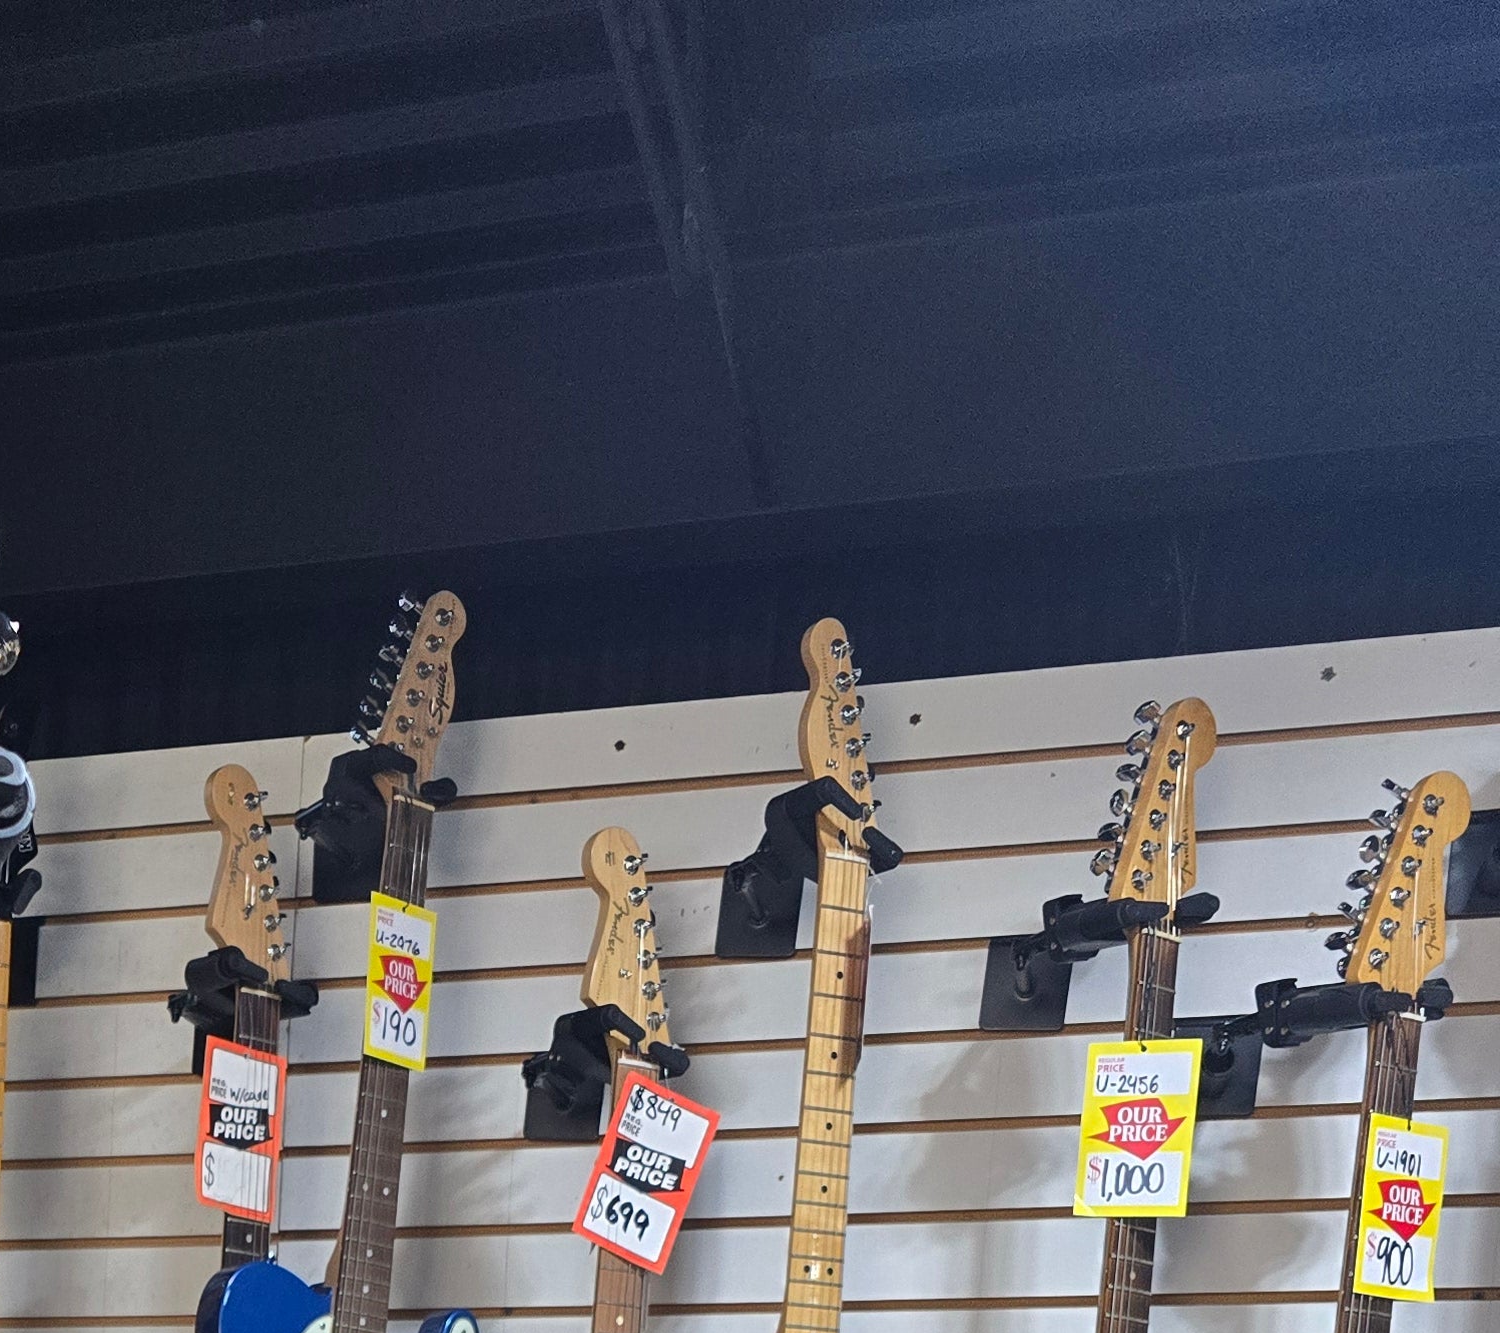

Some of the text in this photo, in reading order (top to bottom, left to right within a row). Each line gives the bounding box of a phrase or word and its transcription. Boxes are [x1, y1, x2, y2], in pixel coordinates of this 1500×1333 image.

[429, 661, 450, 725] Squier
[820, 684, 843, 749] Fender
[607, 898, 630, 955] Fender
[1423, 903, 1440, 960] Fender
[389, 959, 415, 982] OUR
[384, 975, 418, 1001] PRICE
[372, 1000, 417, 1047] $190
[1097, 1063, 1125, 1073] PRICE
[211, 1085, 227, 1099] PRICE
[1096, 1074, 1160, 1094] U-2456
[220, 1106, 258, 1125] OUR
[630, 1086, 682, 1132] $849
[1117, 1106, 1163, 1124] OUR
[213, 1120, 266, 1142] PRICE
[620, 1120, 642, 1138] PRICE
[1108, 1124, 1169, 1143] PRICE
[1376, 1137, 1397, 1149] PRICE
[203, 1151, 215, 1190] $
[626, 1145, 673, 1172] OUR
[1376, 1147, 1422, 1177] U-1901
[613, 1158, 679, 1191] PRICE
[1087, 1155, 1165, 1202] $1,000
[1389, 1184, 1421, 1207] OUR
[590, 1184, 650, 1242] $699
[1381, 1202, 1425, 1226] PRICE
[1366, 1231, 1414, 1286] $900
